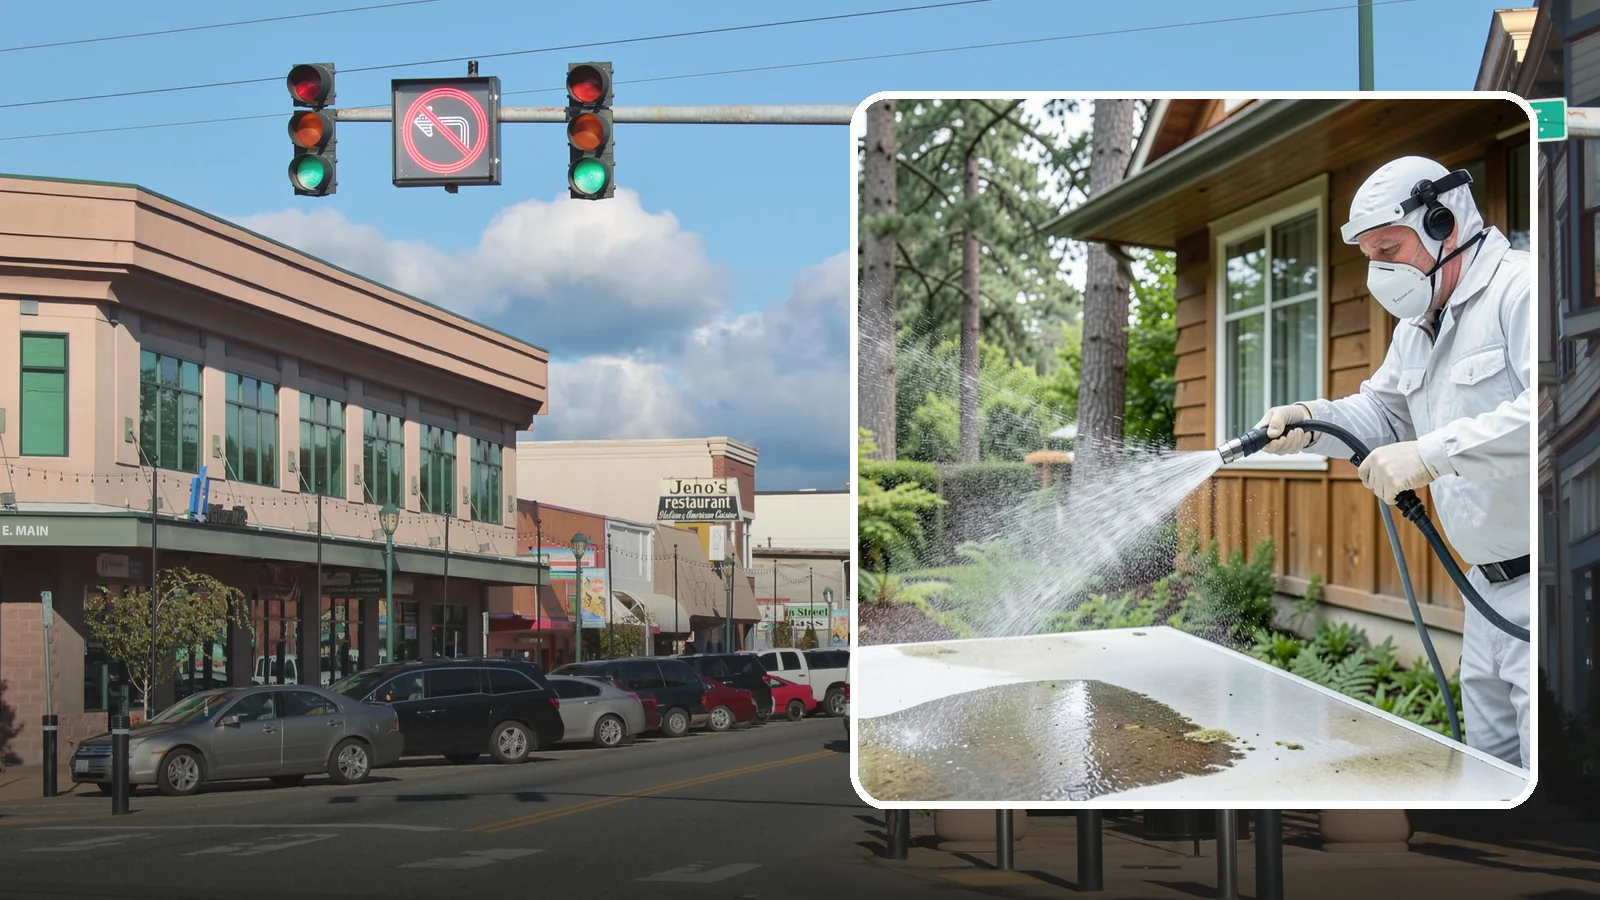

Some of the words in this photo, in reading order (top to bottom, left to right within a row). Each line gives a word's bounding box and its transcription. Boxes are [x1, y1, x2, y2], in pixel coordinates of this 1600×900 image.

[669, 480, 728, 494] Jeno's
[665, 496, 731, 509] restaurant
[659, 510, 681, 520] Italian
[686, 509, 714, 519] American
[715, 509, 737, 519] Cuisine
[2, 525, 13, 536] E.
[16, 525, 49, 536] MAIN
[797, 607, 829, 616] Street
[791, 619, 824, 627] lass
